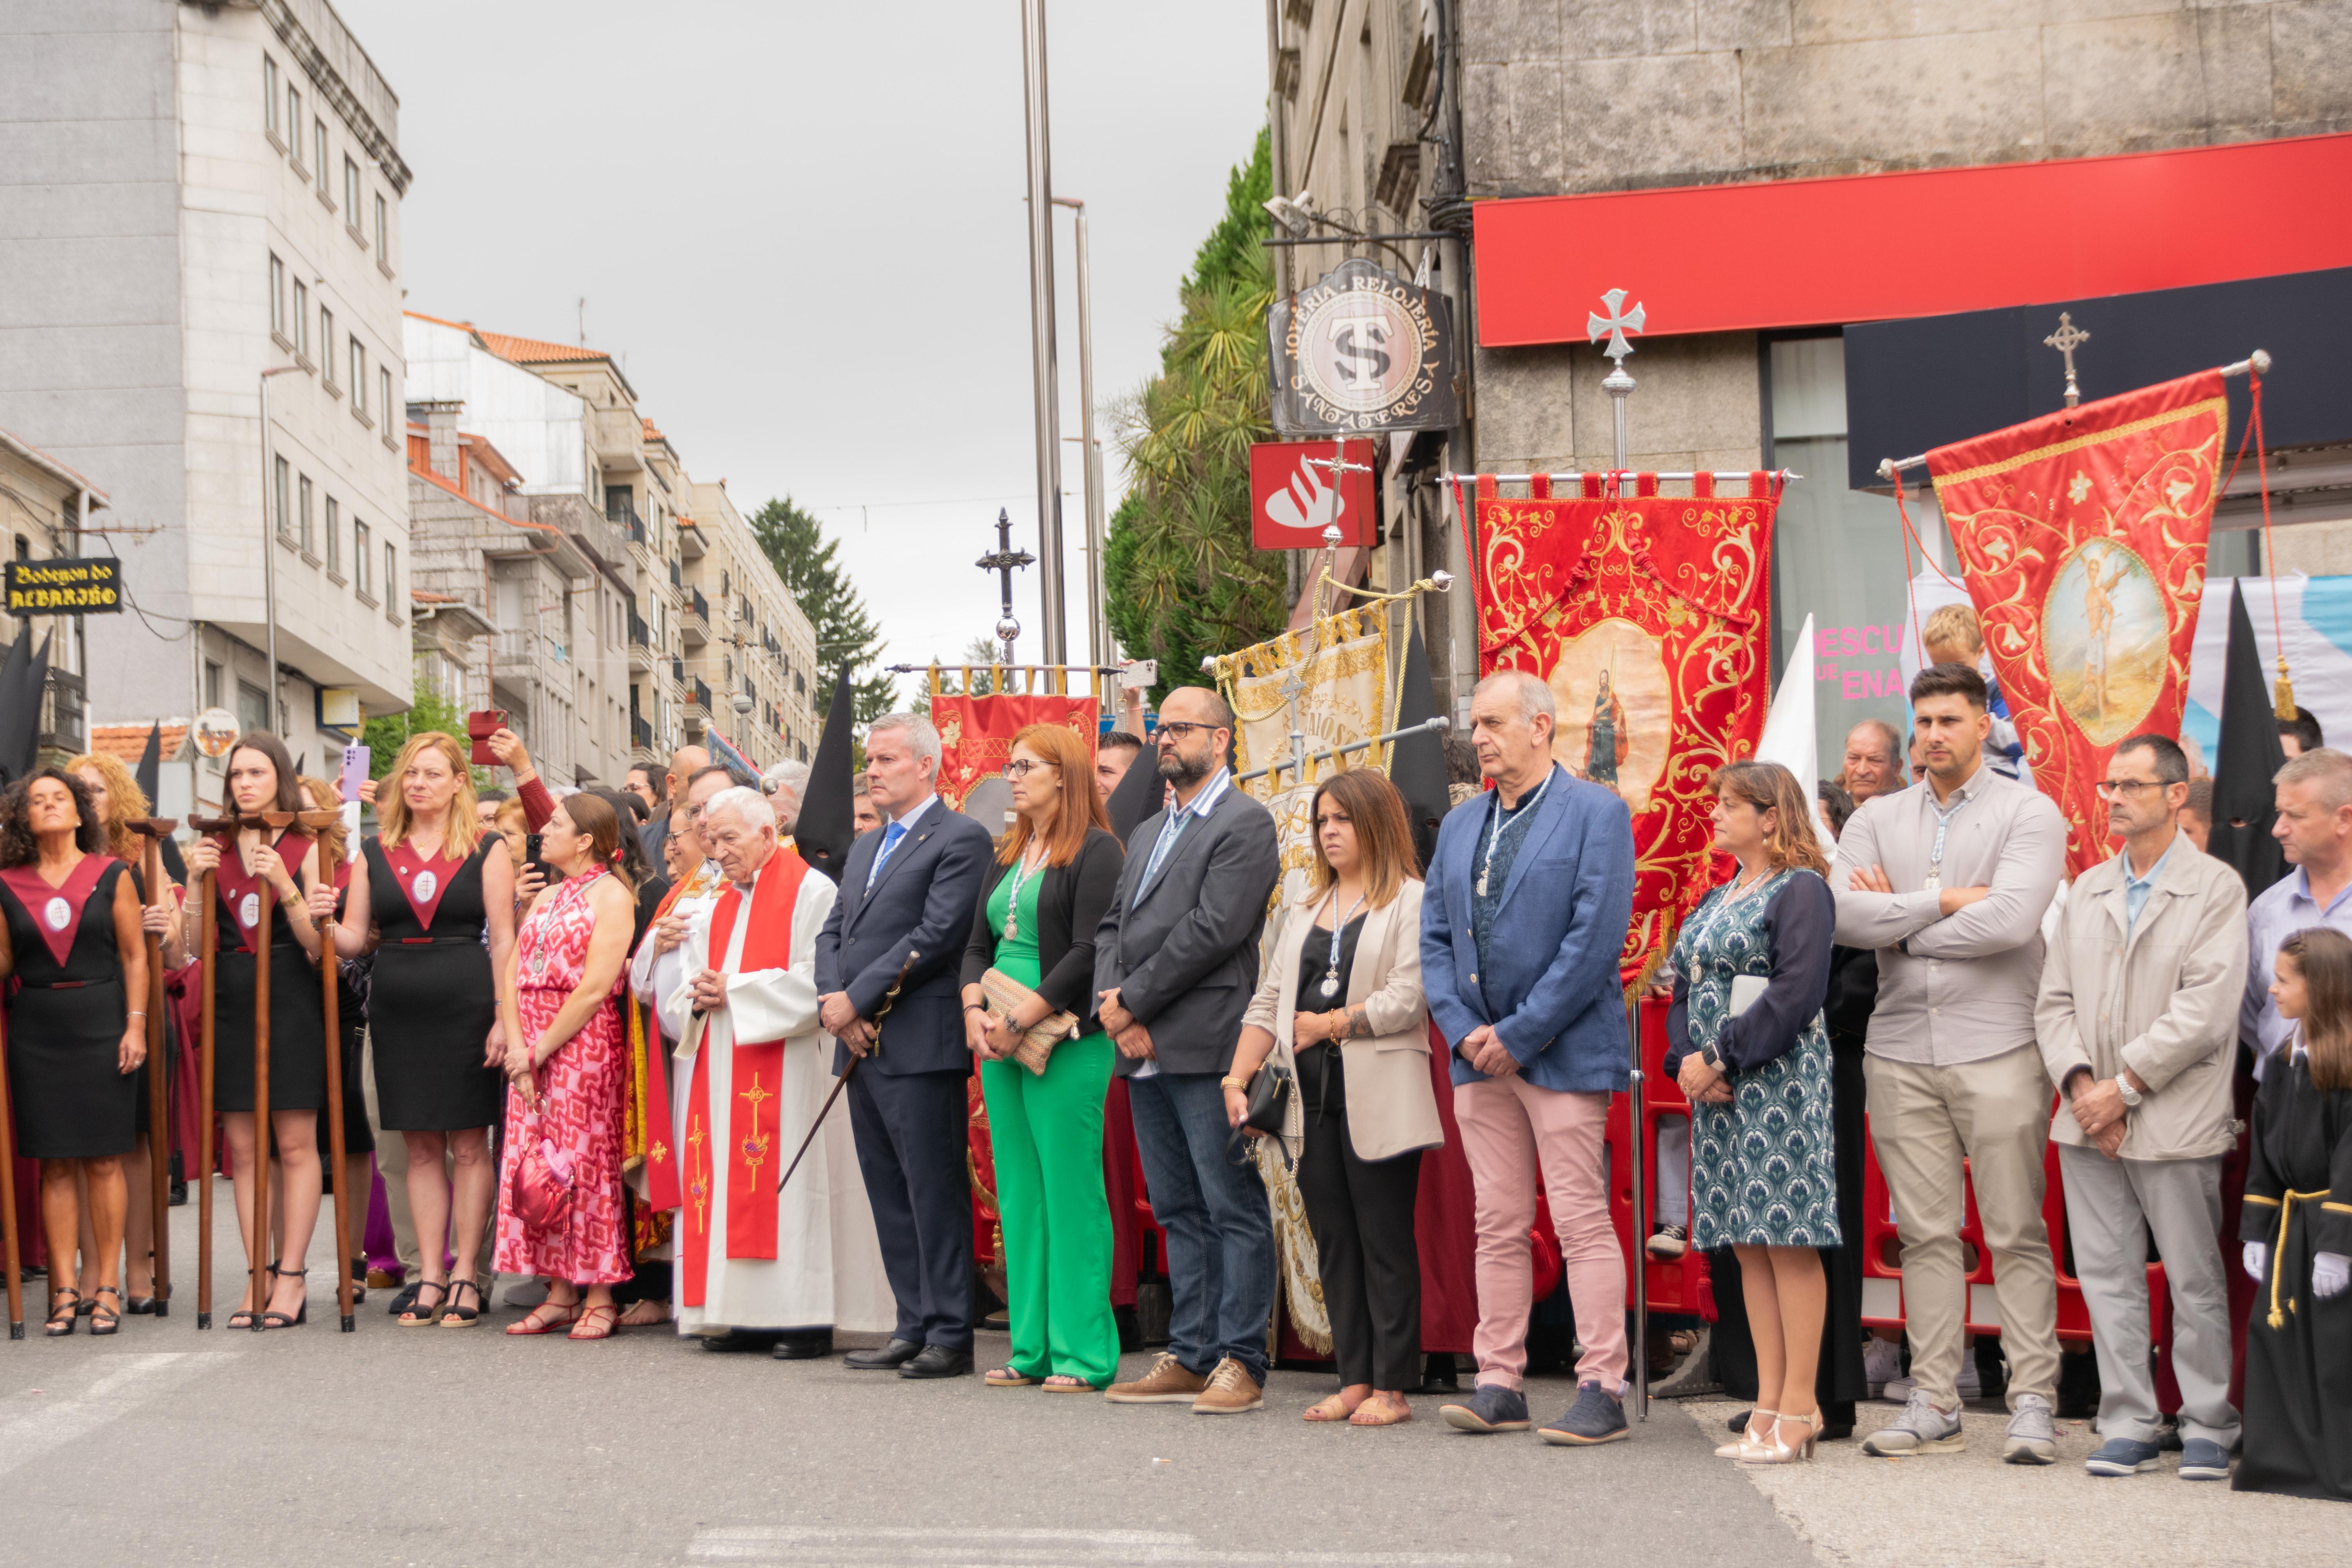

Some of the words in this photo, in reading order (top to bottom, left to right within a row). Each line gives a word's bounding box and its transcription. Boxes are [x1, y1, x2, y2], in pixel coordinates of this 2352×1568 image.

[1285, 285, 1337, 360] JOYERÍA
[1352, 276, 1439, 352] RELOJERÍA
[91, 563, 113, 580] do
[9, 583, 117, 610] ALBARIÑO
[751, 1090, 762, 1100] IHS
